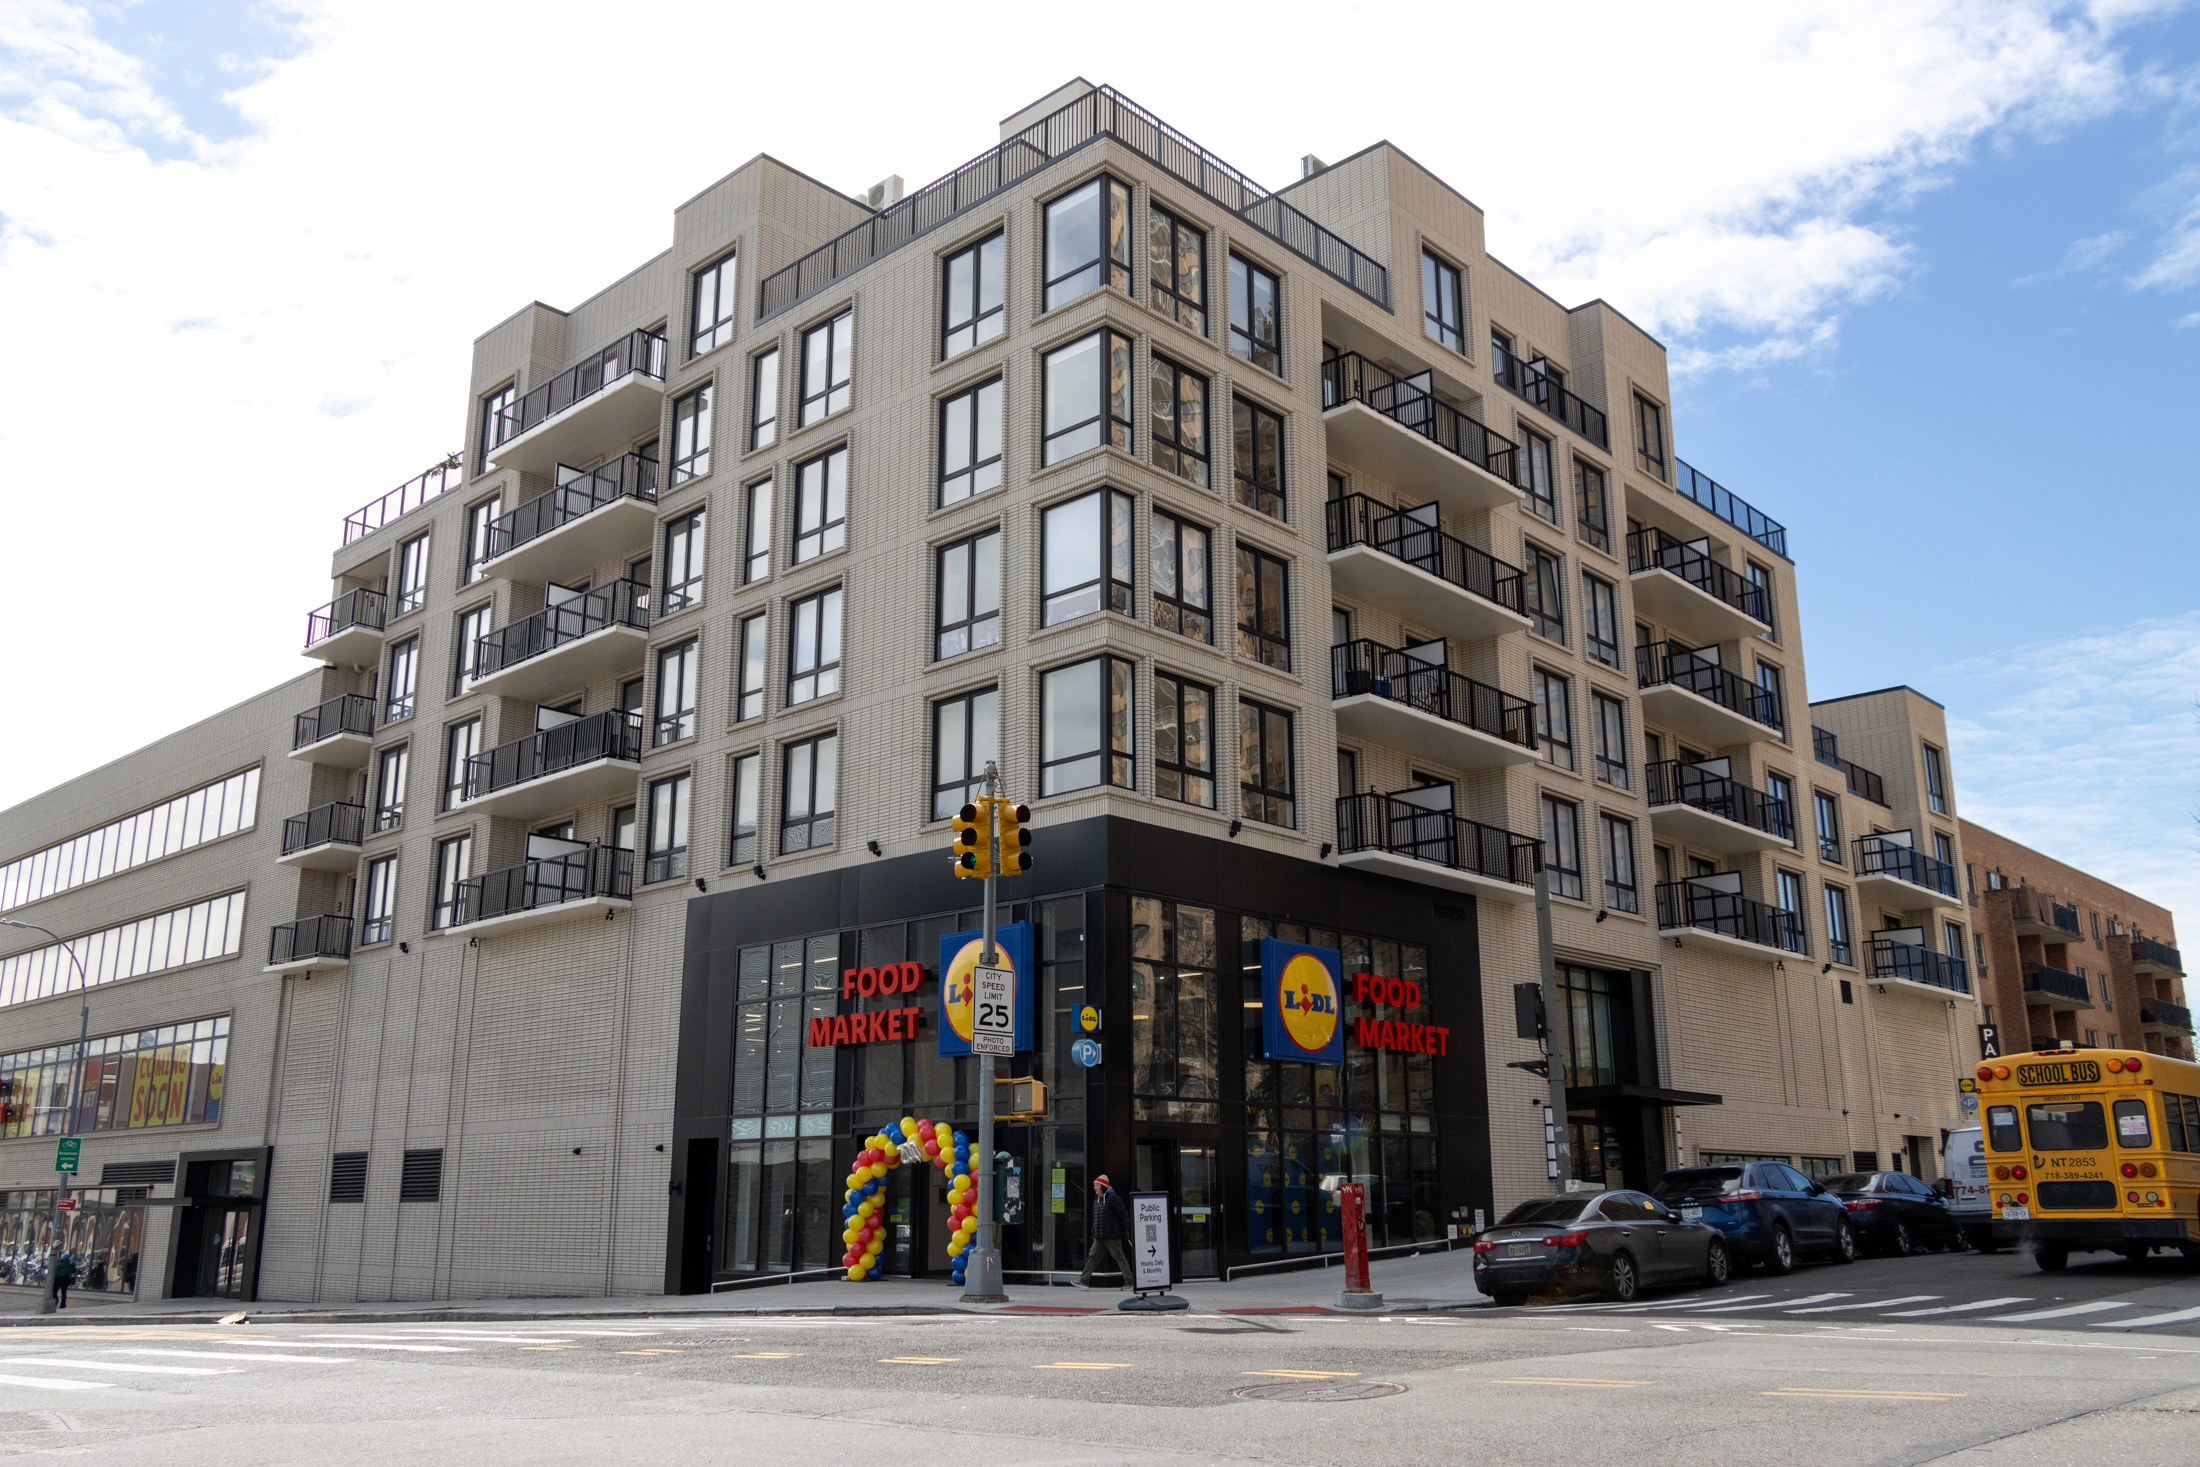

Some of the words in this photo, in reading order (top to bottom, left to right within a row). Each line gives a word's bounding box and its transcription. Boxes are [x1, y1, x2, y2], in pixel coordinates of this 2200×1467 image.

[843, 961, 925, 1000] FOOD
[985, 971, 1002, 981] CITY
[982, 981, 1006, 992] SPEED
[1352, 972, 1420, 1010] FOOD
[984, 991, 1003, 1001] LIMIT
[979, 1003, 1009, 1028] 25
[808, 1007, 925, 1048] MARKET
[982, 1036, 1005, 1045] PHOTO
[1354, 1016, 1450, 1056] MARKET
[976, 1043, 1011, 1053] ENFORCED
[1083, 1044, 1092, 1061] P
[139, 1049, 187, 1080] COMING
[2019, 1064, 2069, 1085] SCHOOL
[2071, 1063, 2097, 1081] BUS
[133, 1081, 184, 1123] SOON
[1967, 1098, 1975, 1107] P
[2051, 1158, 2067, 1167] NT
[2069, 1157, 2096, 1167] 2853
[2044, 1171, 2104, 1180] 718-389-4241
[1141, 1203, 1160, 1212] Public
[1140, 1213, 1162, 1223] Parking
